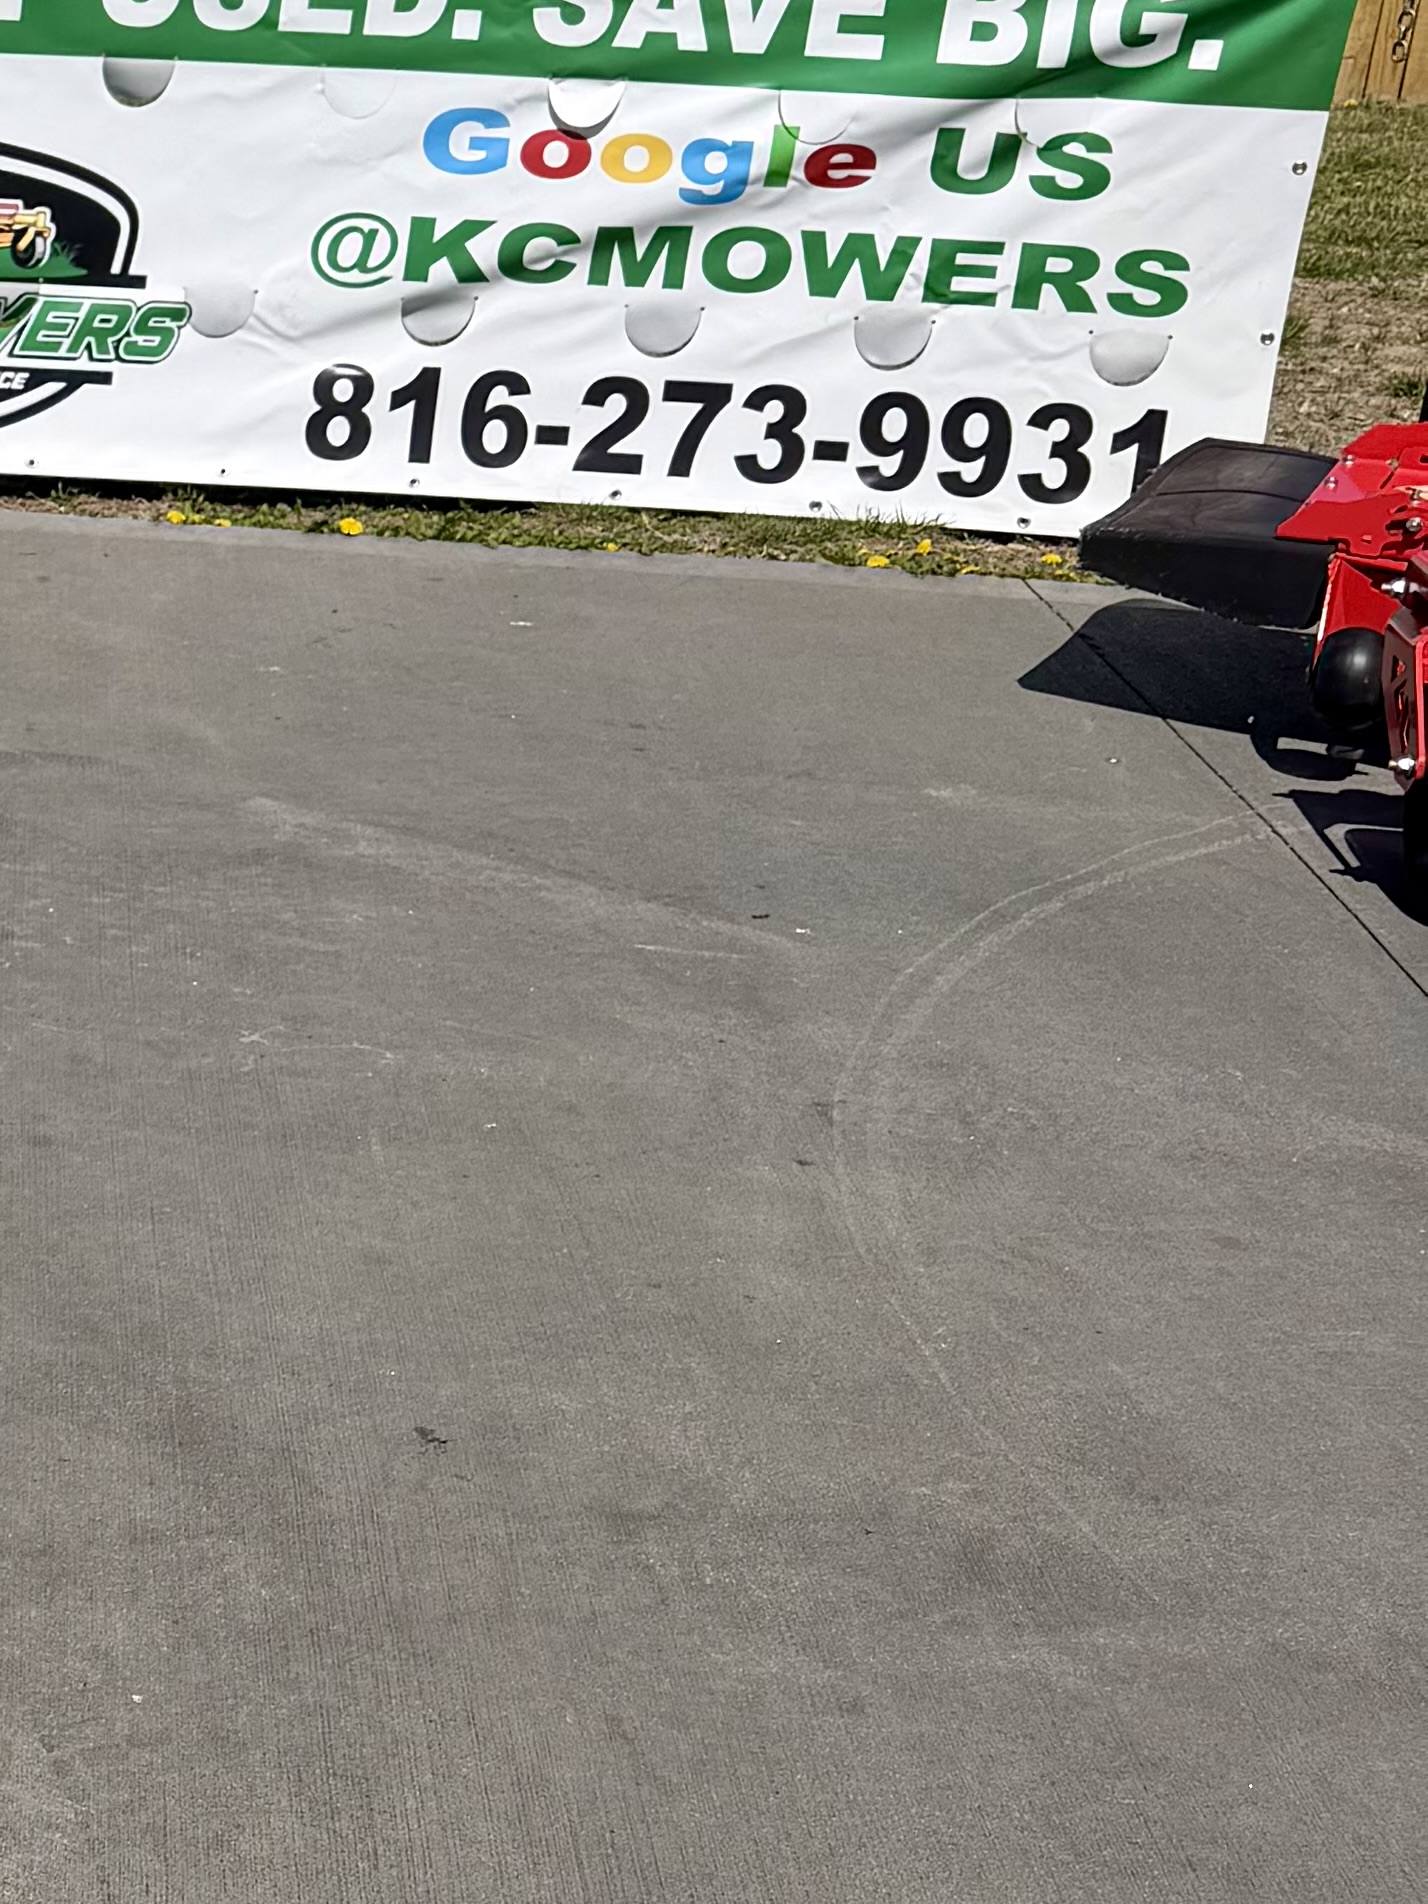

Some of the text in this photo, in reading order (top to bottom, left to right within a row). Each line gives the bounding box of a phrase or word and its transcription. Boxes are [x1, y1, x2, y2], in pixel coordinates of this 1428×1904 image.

[422, 107, 1114, 205] Google US
[310, 211, 1191, 318] @KCMOWERS
[304, 364, 1168, 505] 816-273-9931
